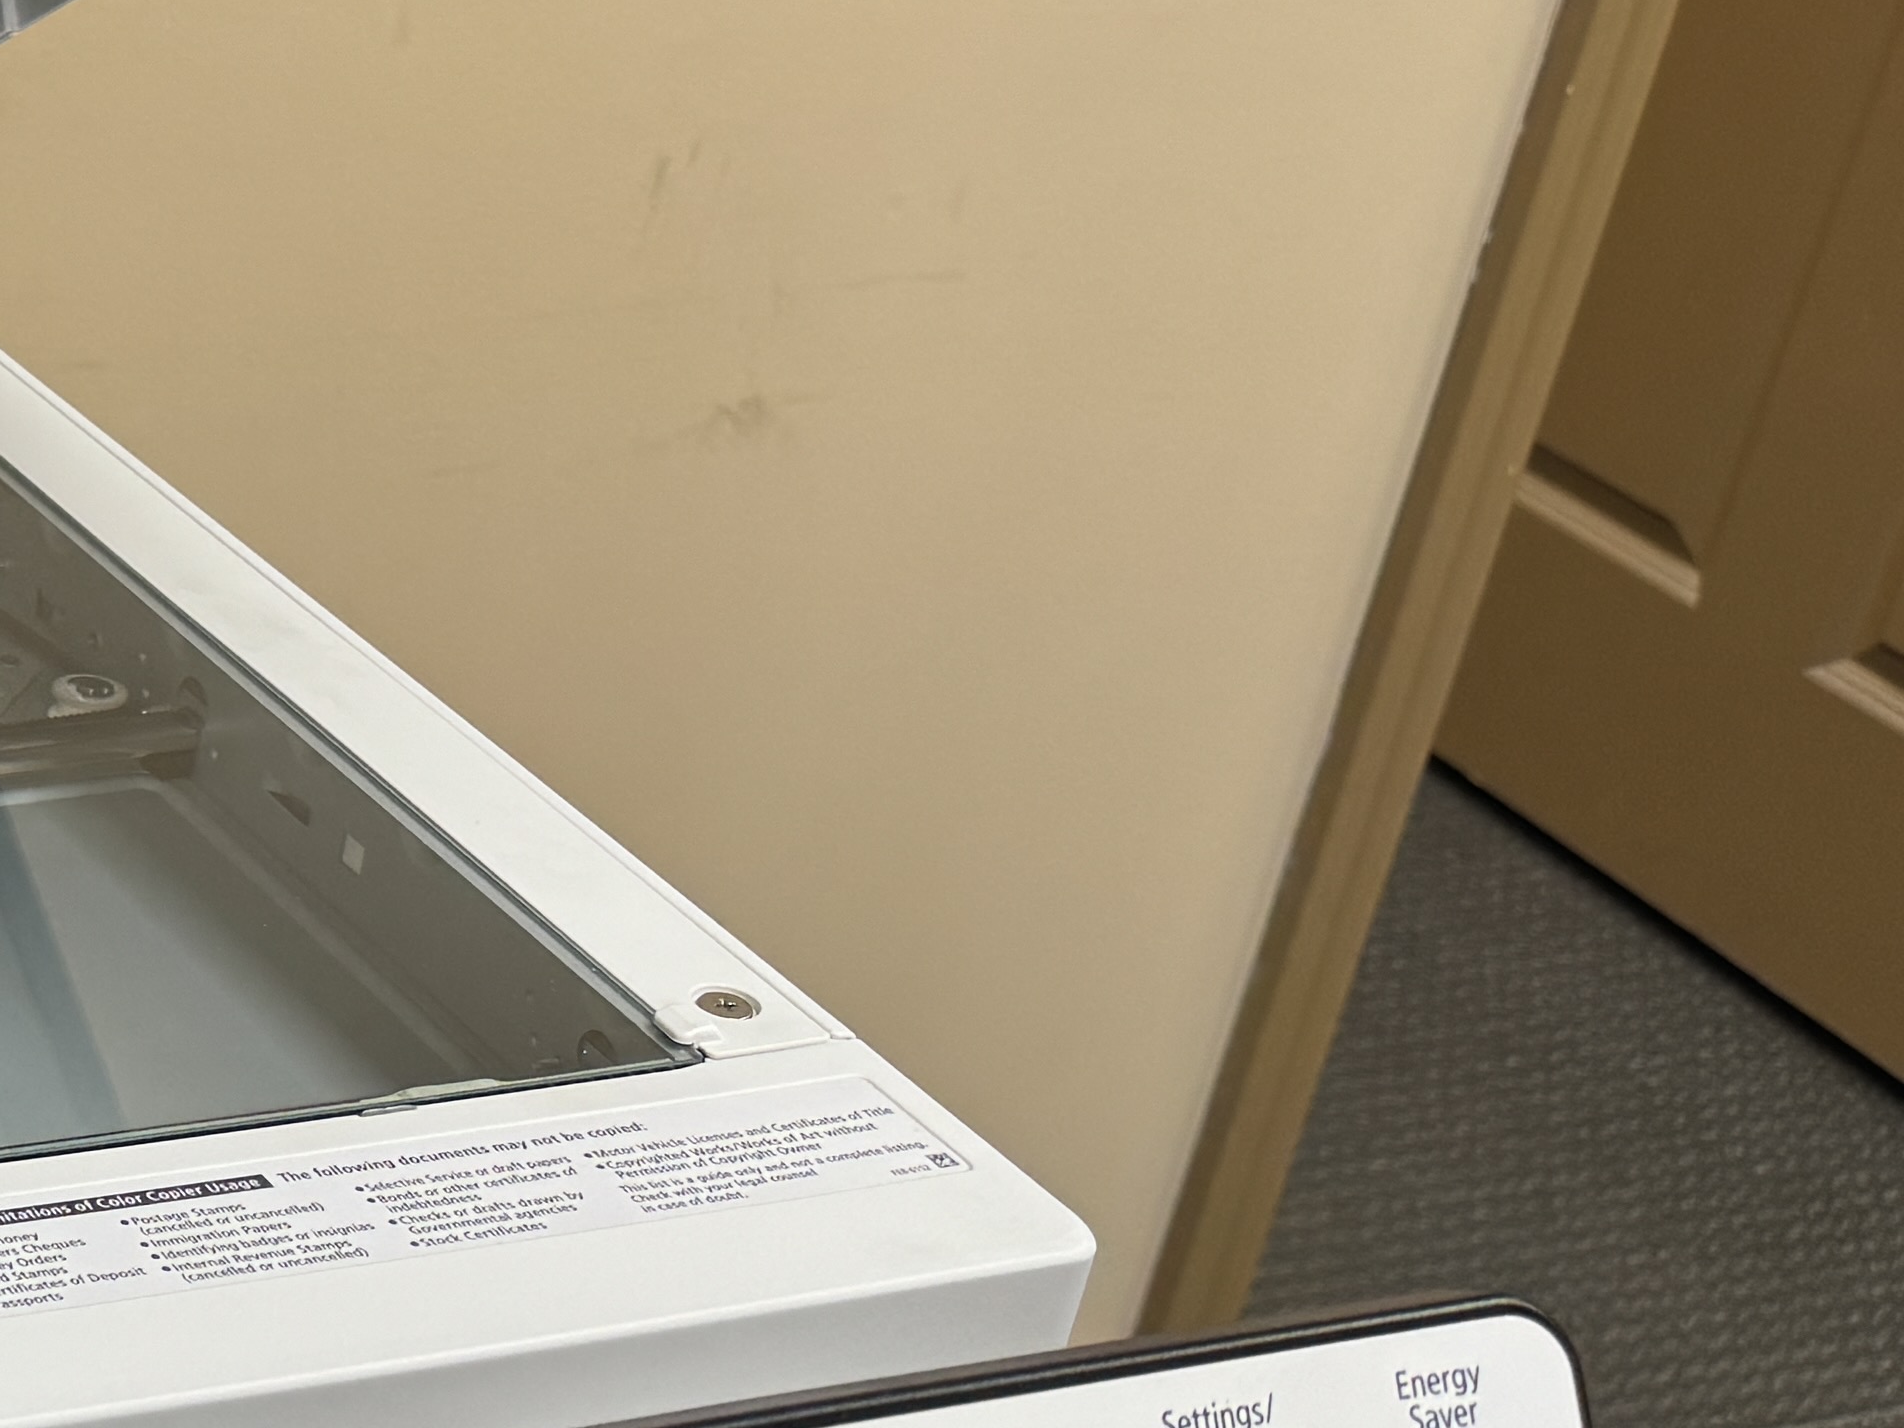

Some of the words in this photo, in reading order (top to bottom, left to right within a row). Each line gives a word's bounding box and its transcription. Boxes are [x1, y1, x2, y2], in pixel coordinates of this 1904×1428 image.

[276, 1171, 312, 1183] The
[312, 1160, 397, 1178] following
[398, 1146, 490, 1166] documents
[492, 1140, 528, 1152] may
[530, 1135, 562, 1147] not
[559, 1132, 585, 1142] be
[587, 1121, 648, 1138] copied:
[75, 1200, 92, 1212] of
[96, 1194, 143, 1209] Color
[146, 1186, 203, 1205] Copier
[205, 1178, 260, 1195] Usage
[131, 1210, 189, 1225] Postage
[191, 1202, 246, 1217] Stamps
[21, 1239, 87, 1254] Cheques
[16, 1254, 67, 1267] Orders
[11, 1266, 69, 1281] Stamps
[69, 1274, 86, 1286] of
[86, 1267, 147, 1283] Deposit
[1395, 1365, 1480, 1402] Energy
